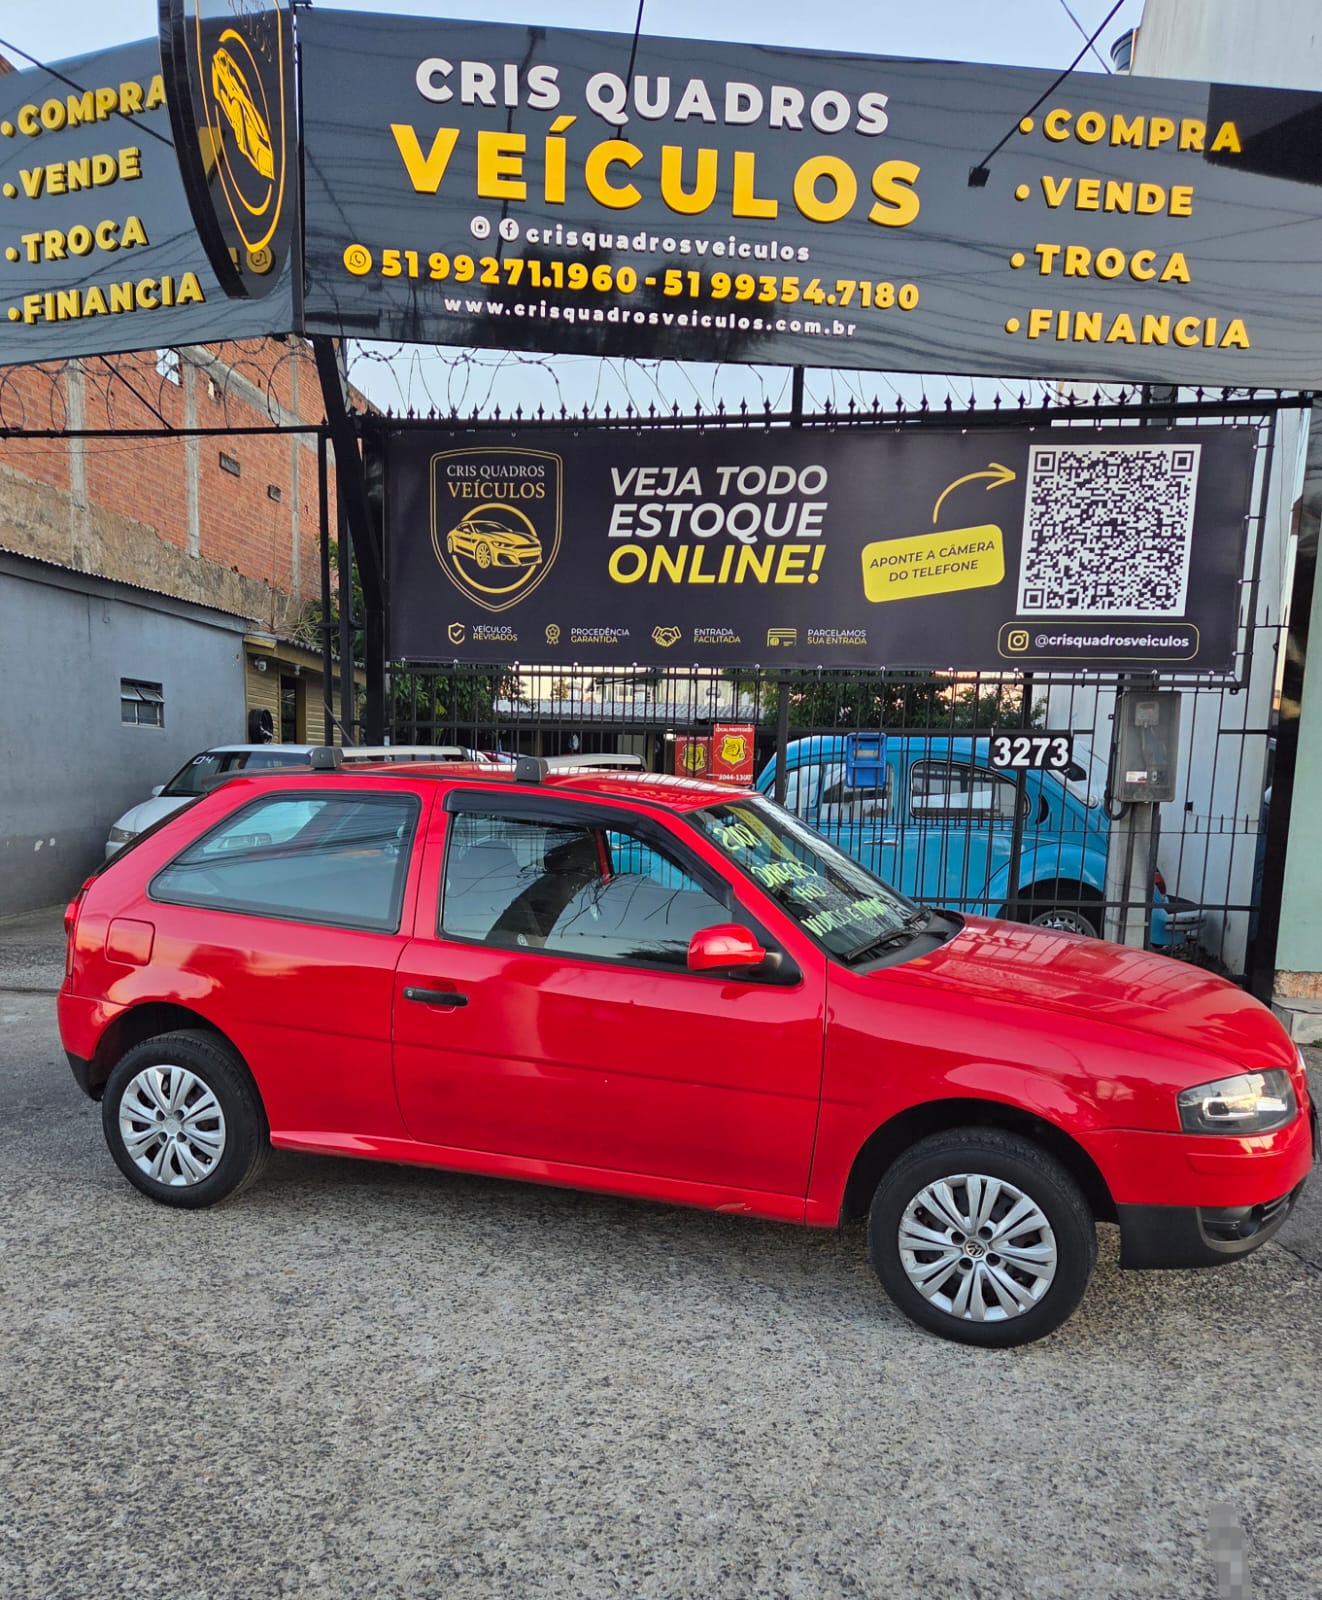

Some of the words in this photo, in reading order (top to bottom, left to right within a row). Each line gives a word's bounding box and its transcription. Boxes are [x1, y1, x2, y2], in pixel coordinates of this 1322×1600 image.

[17, 74, 167, 137] COMPRA
[415, 57, 561, 109] CRIS
[585, 72, 890, 136] QUADROS
[1043, 108, 1242, 153] COMPRA
[18, 146, 141, 199] VENDE
[389, 114, 922, 228] VEÍCULOS
[1041, 175, 1194, 217] VENDE
[21, 215, 149, 264] TROCA
[525, 223, 811, 263] crisquadrosveiculos
[381, 248, 419, 279] 51
[427, 251, 639, 294] 99271.1960
[663, 269, 701, 299] 51
[710, 270, 920, 311] 99354.7180
[1034, 243, 1192, 283] TROCA
[22, 271, 206, 324] FINANCIA
[443, 296, 857, 337] www.crisquadrosveiculos.com.br
[1027, 308, 1252, 349] FINANCIA
[446, 464, 477, 478] CRIS
[479, 464, 545, 479] QUADROS
[447, 478, 546, 499] VEÍCULOS
[610, 466, 703, 497] VEJA
[716, 464, 829, 497] TODO
[607, 501, 829, 545] ESTOQUE
[607, 543, 828, 585] ONLINE!
[869, 550, 924, 570] APONTE
[925, 549, 936, 561] A
[937, 539, 996, 560] CÂMERA
[888, 570, 909, 583] DO
[912, 559, 979, 580] TELEFONE
[472, 623, 513, 634] VEÍCULOS
[472, 632, 519, 642] REVISADOS
[570, 626, 631, 637] PROCEDÊNCIA
[570, 634, 619, 644] GARANTIDA
[693, 627, 734, 637] ENTRADA
[693, 634, 742, 644] FACILITADA
[807, 628, 867, 638] PARCELAMOS
[807, 635, 825, 645] SUA
[826, 636, 868, 646] ENTRADA
[1034, 633, 1190, 649] @crisquadrosveiculos
[992, 737, 1070, 768] 3273
